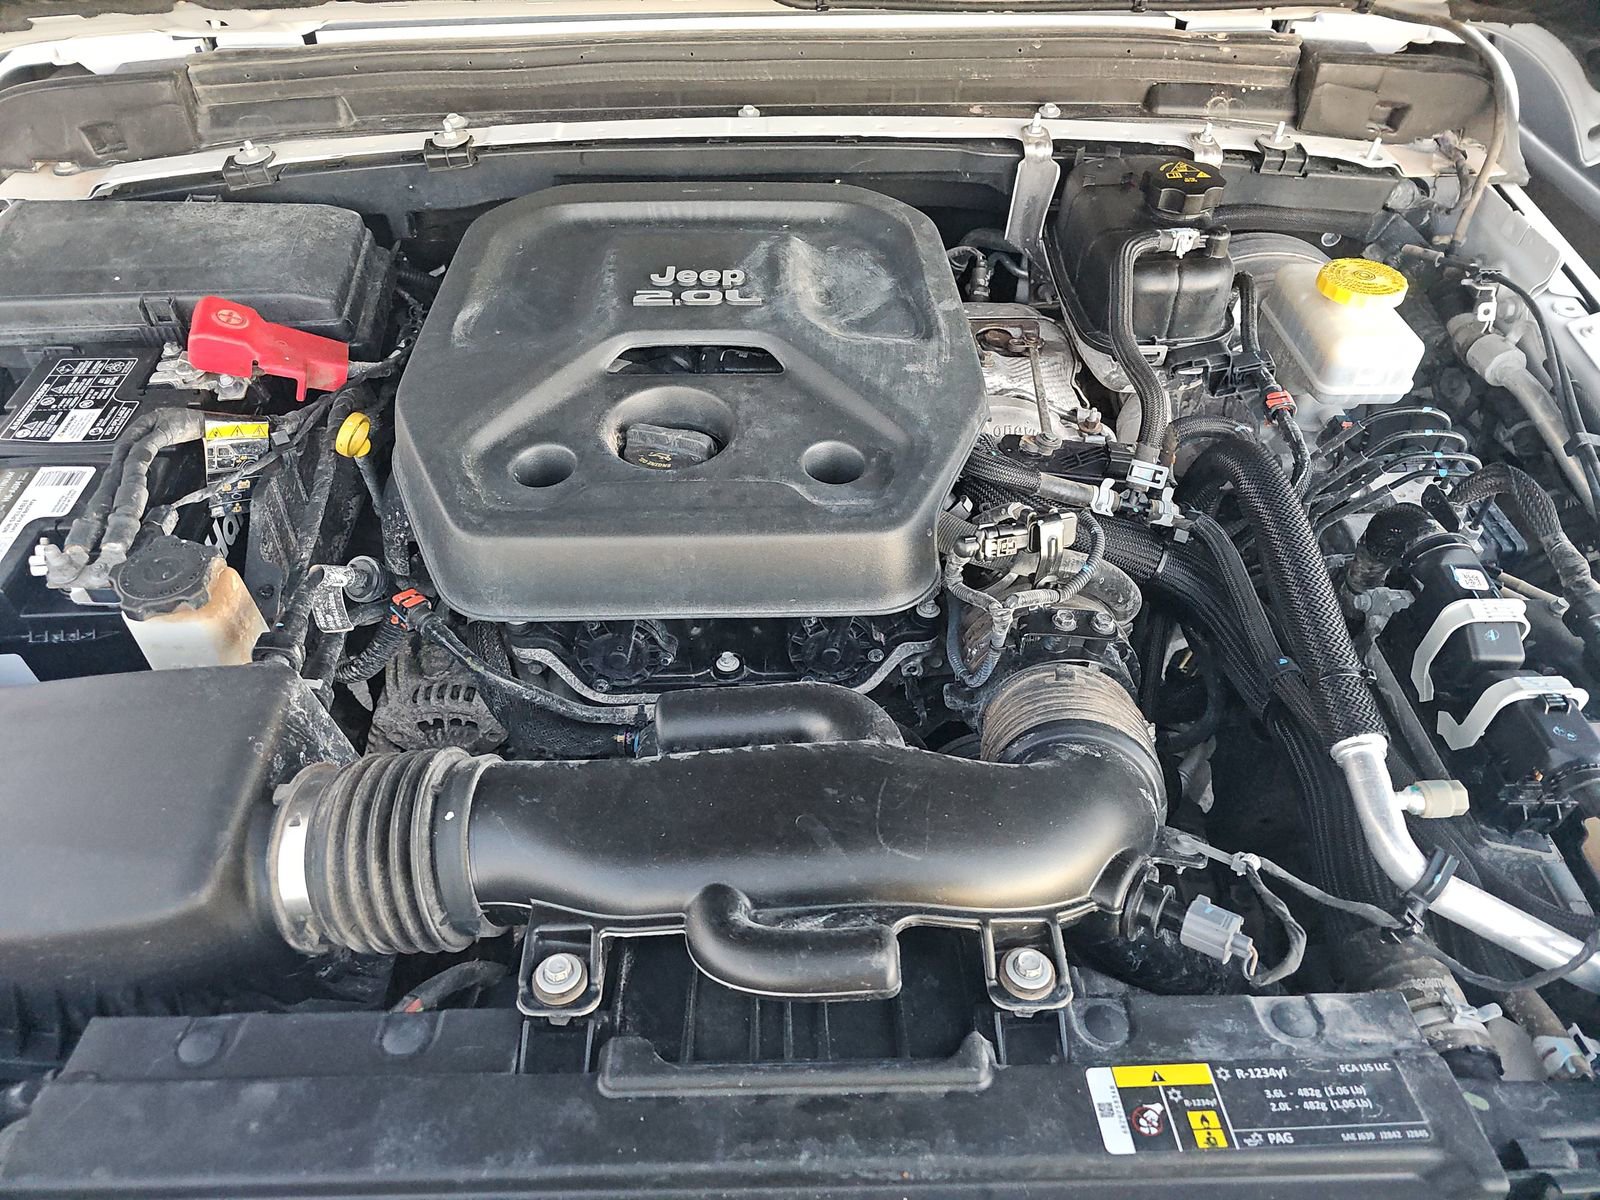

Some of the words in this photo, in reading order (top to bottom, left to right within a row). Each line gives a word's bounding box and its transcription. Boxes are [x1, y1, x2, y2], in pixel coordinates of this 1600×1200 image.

[650, 266, 746, 289] Jeep
[632, 289, 763, 306] 2.0L
[1235, 1066, 1288, 1080] R-1234yf
[1339, 1063, 1359, 1073] FCA
[1359, 1063, 1374, 1073] US
[1374, 1062, 1392, 1072] LLC
[1263, 1089, 1287, 1099] 3.6L
[1297, 1087, 1322, 1099] 482g
[1324, 1085, 1350, 1097] (1.06
[1269, 1101, 1292, 1112] 2.0L
[1303, 1100, 1328, 1112] 482g
[1329, 1098, 1356, 1111] (1.06
[1267, 1131, 1295, 1145] PAG
